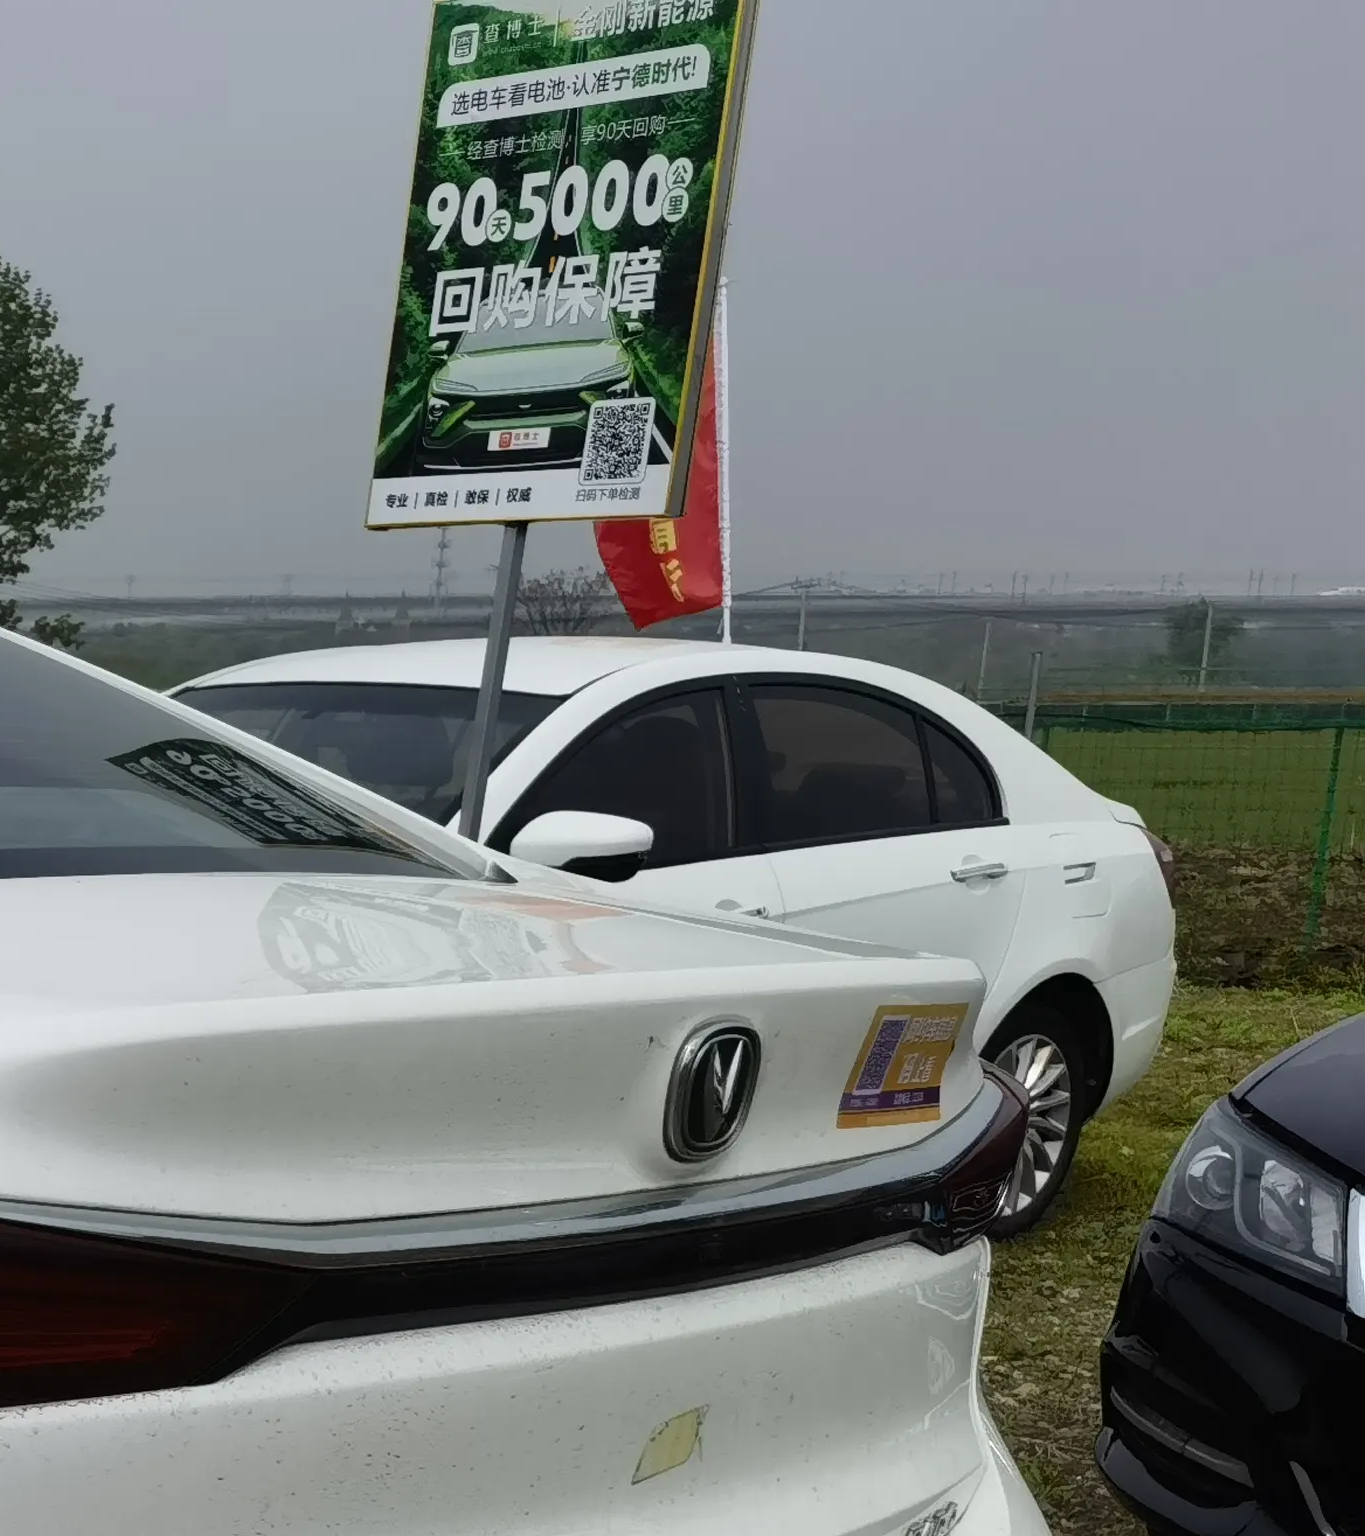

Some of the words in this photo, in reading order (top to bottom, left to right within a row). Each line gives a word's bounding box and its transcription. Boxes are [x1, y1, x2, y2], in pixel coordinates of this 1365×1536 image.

[483, 15, 545, 43] 查博士
[571, 0, 714, 41] 金刚新能源
[430, 246, 660, 336] 回购保障
[386, 493, 409, 508] 专业
[507, 487, 532, 503] 权威
[575, 486, 641, 502] 扫码下单检测
